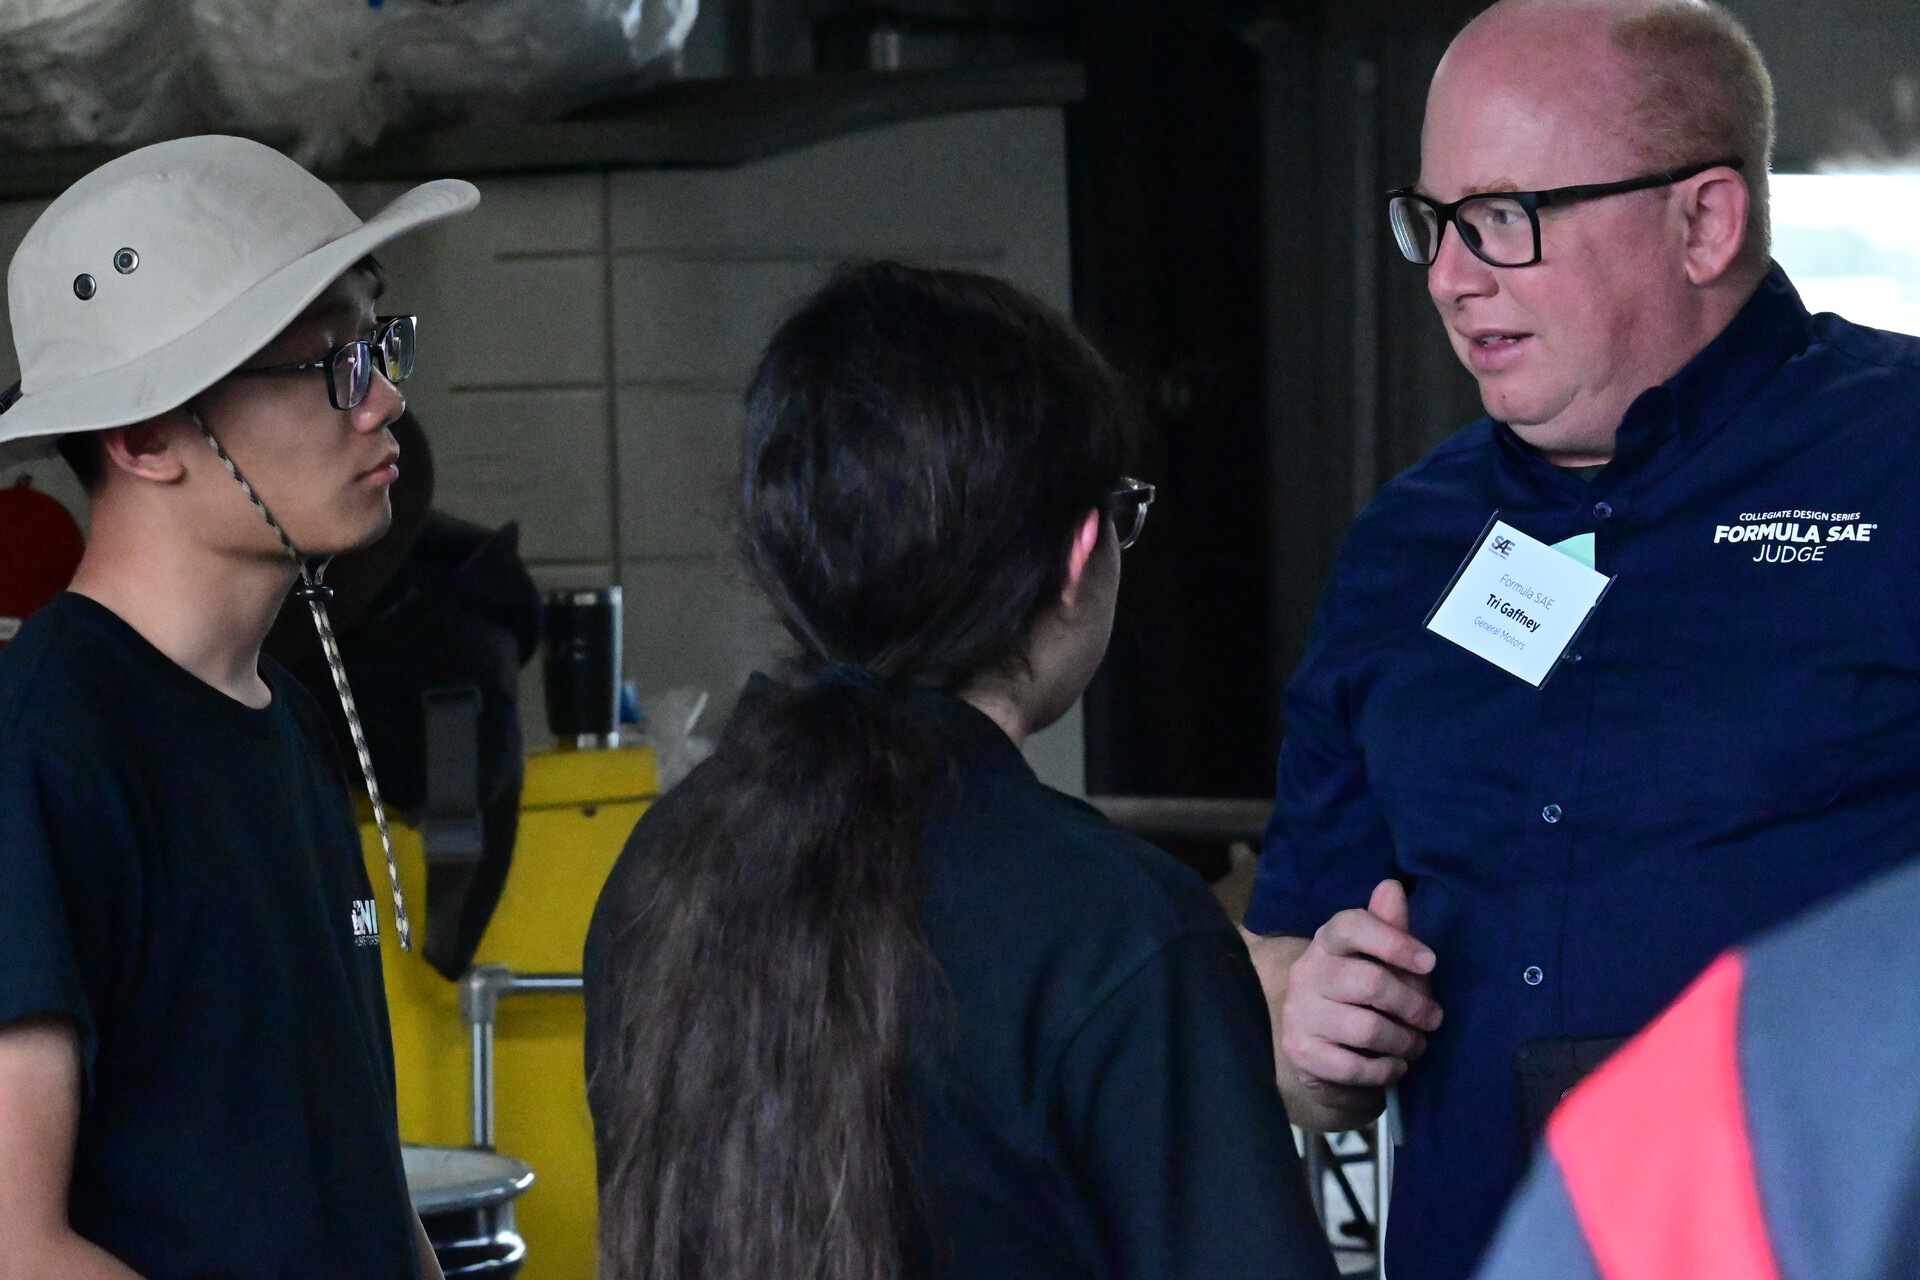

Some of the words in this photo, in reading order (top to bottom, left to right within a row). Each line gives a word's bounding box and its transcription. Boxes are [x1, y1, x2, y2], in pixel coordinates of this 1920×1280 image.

[1739, 510, 1791, 521] COLLEGIATE
[1793, 509, 1829, 521] DESIGN
[1830, 512, 1861, 522] SERIES
[1713, 522, 1820, 544] FORMULA
[1491, 535, 1516, 557] SAE
[1752, 544, 1827, 563] JUDGE
[1500, 573, 1534, 600] Formula
[1533, 592, 1556, 611] SAE
[1486, 593, 1502, 610] Tri
[1500, 602, 1541, 633] Gaffney
[1474, 616, 1501, 636] General
[1500, 630, 1526, 651] Motors
